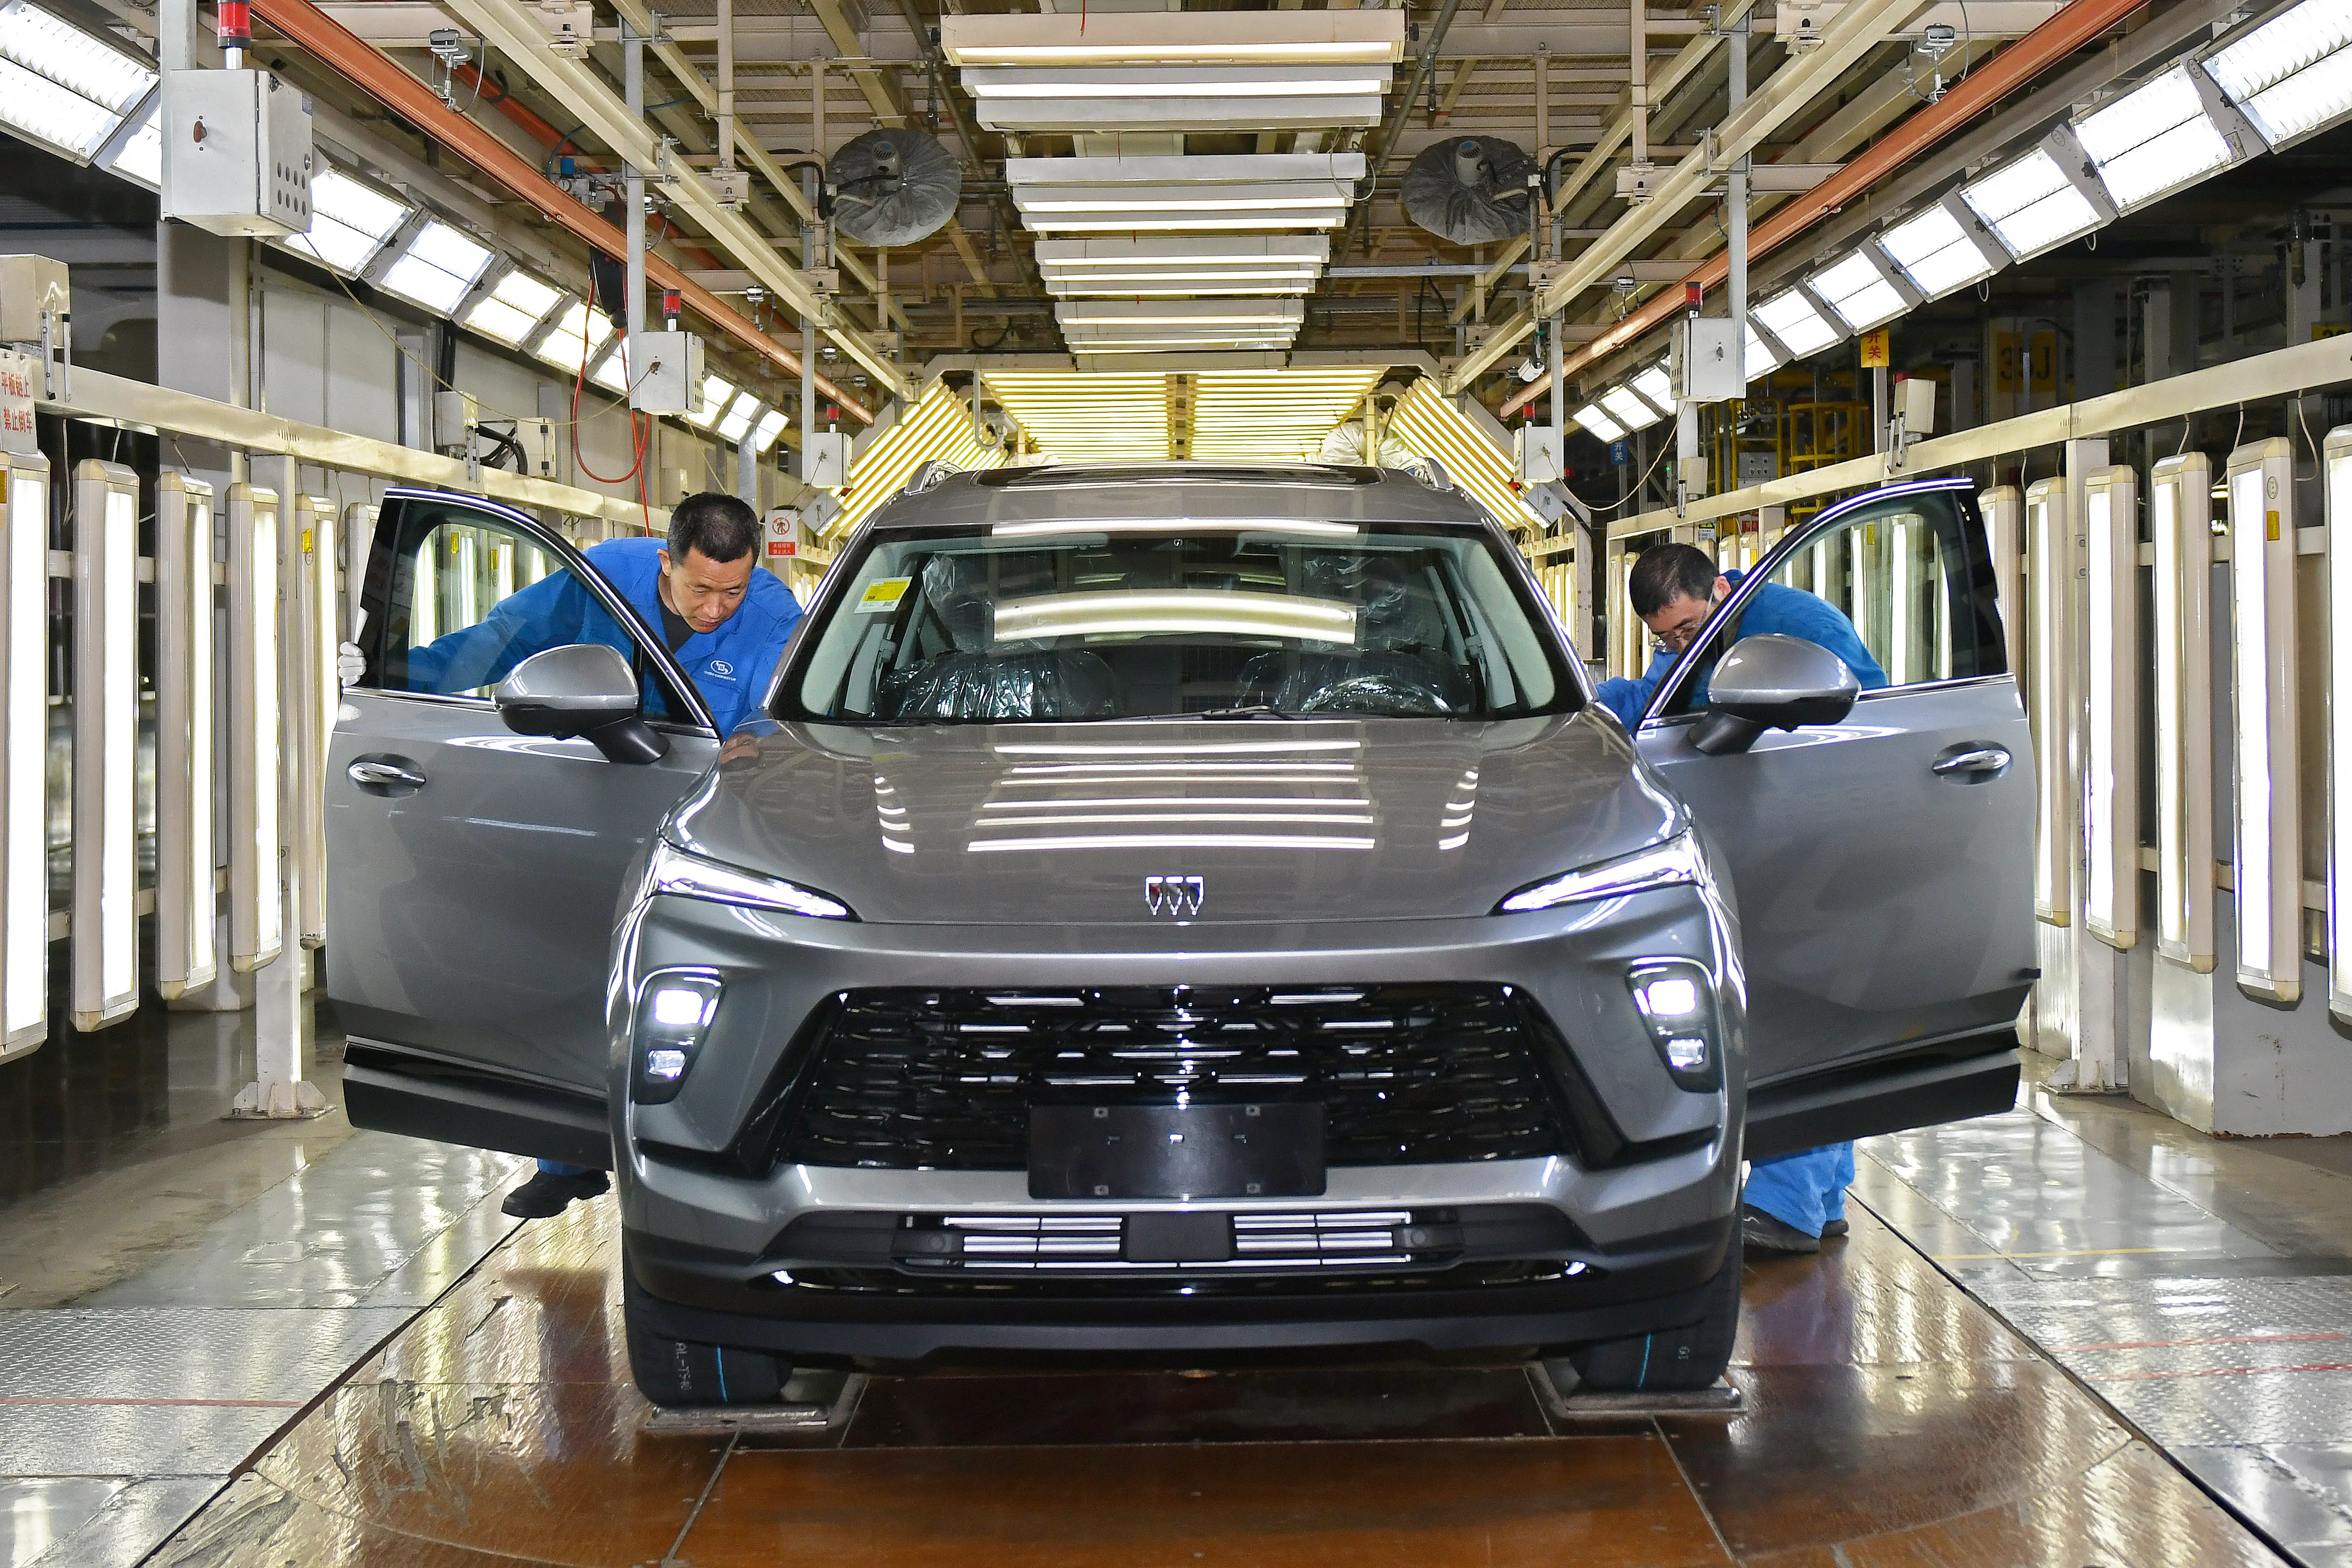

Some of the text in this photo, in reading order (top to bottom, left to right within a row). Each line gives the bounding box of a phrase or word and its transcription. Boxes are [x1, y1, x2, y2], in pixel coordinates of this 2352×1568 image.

[4, 406, 32, 434] 禁止倒车
[1614, 442, 1623, 461] 开关
